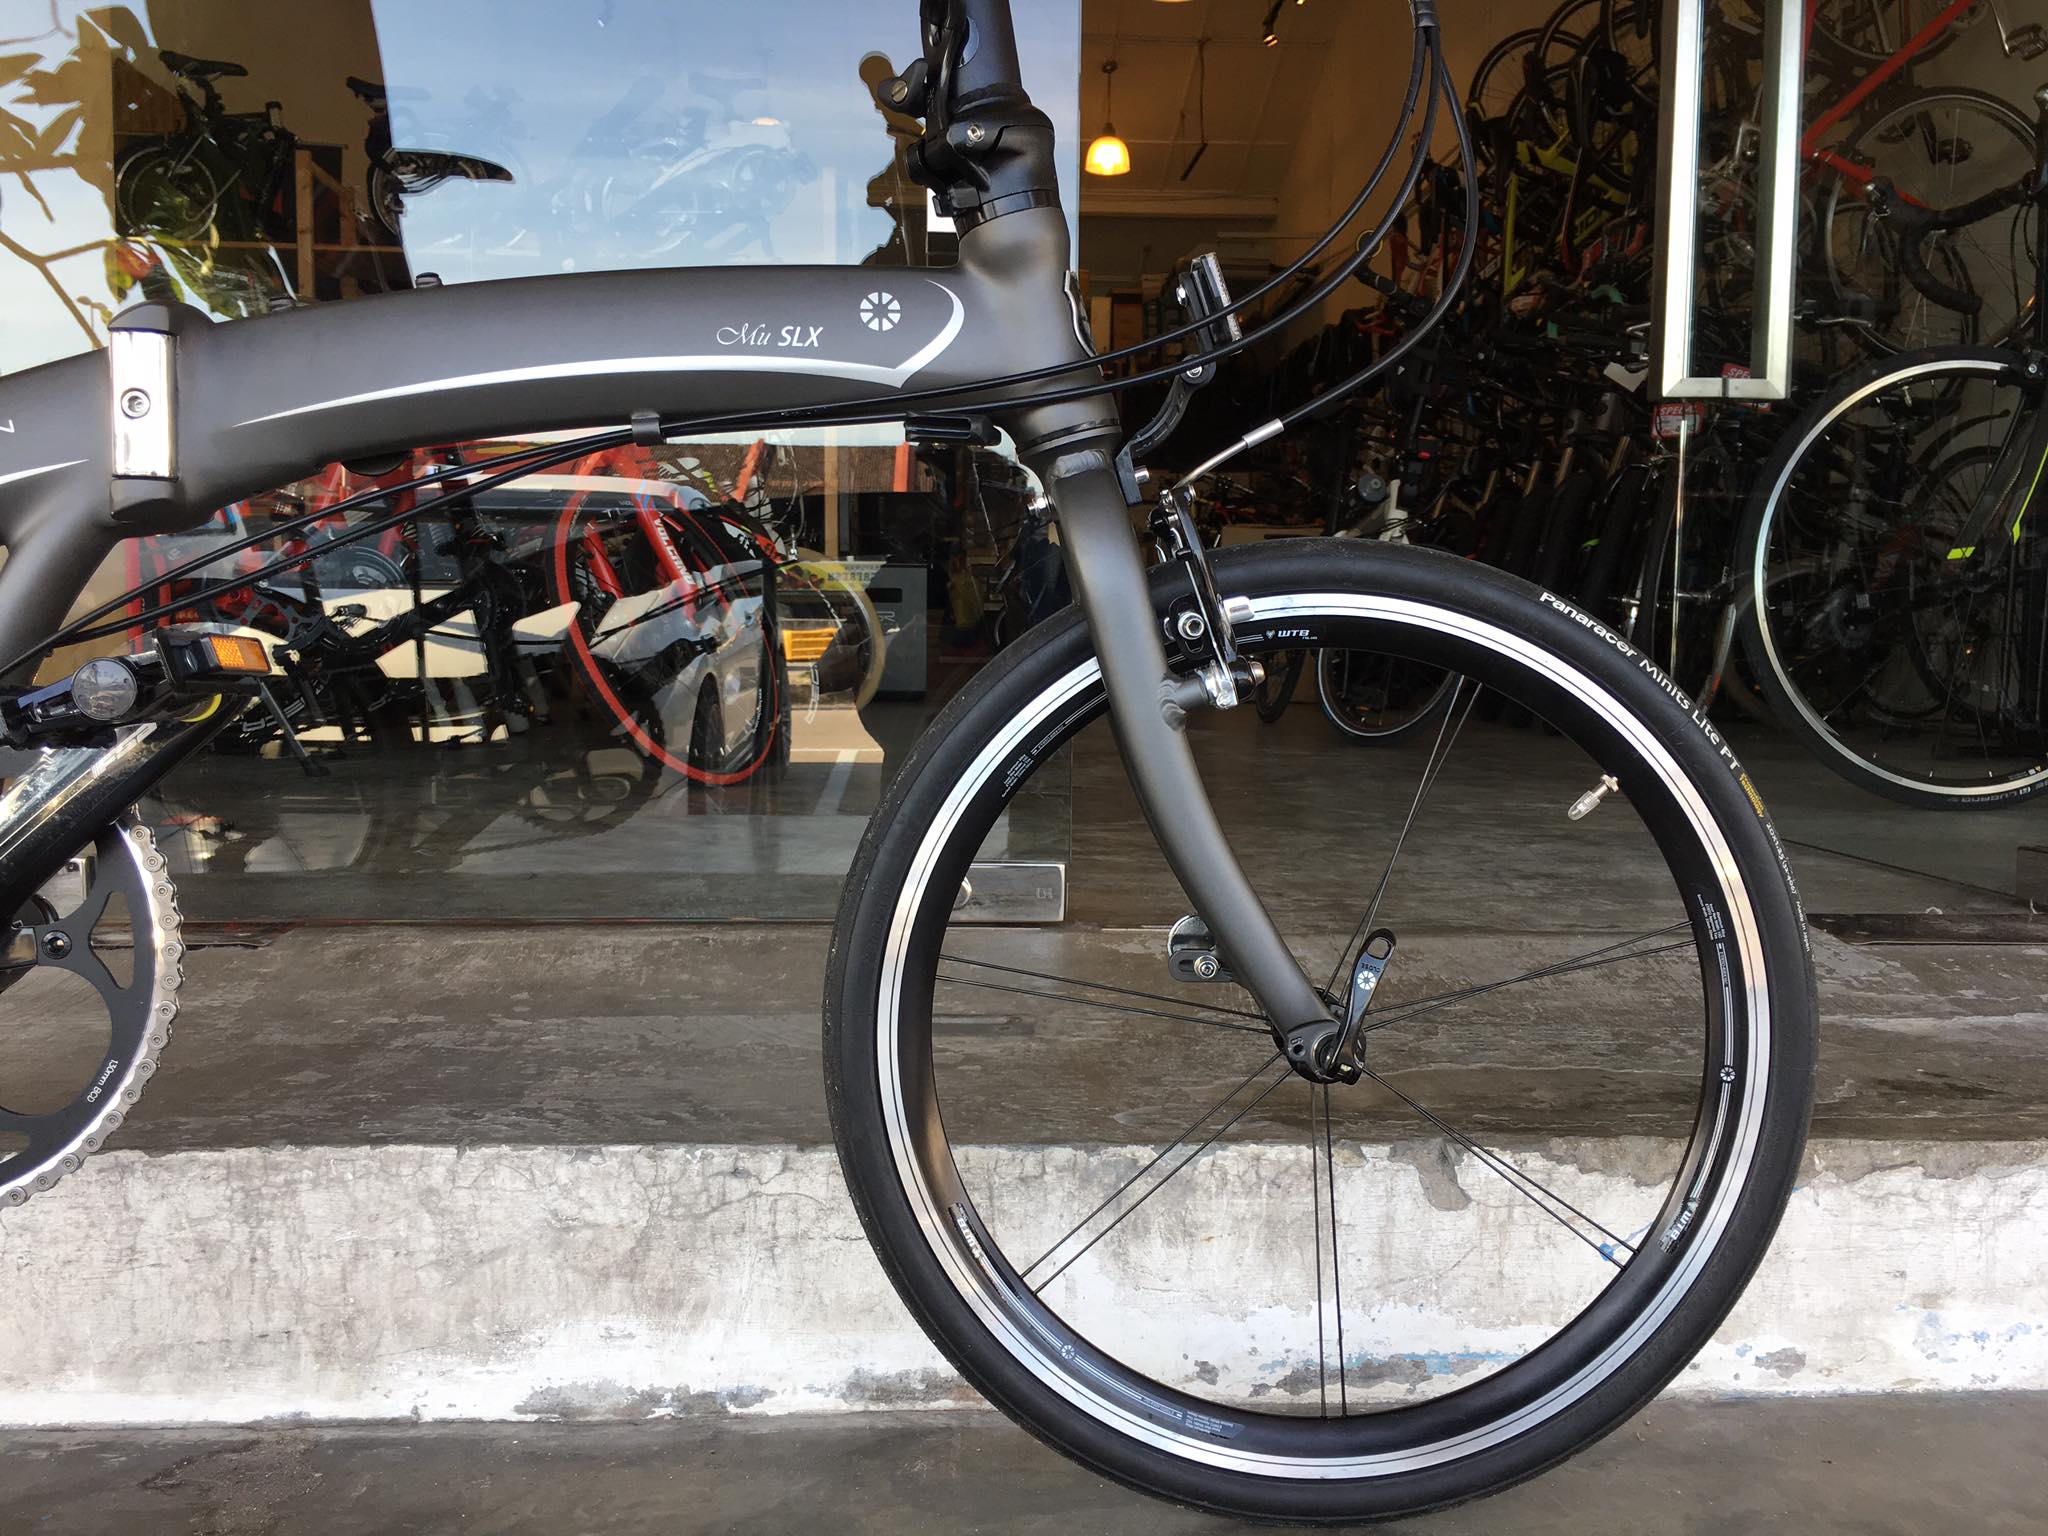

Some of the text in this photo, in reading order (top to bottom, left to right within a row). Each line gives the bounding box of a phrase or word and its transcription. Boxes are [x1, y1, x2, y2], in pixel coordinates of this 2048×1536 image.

[777, 325, 824, 347] SLX
[1277, 629, 1310, 637] WTB
[1540, 591, 1638, 657] Panaracer
[1692, 709, 1720, 745] Lite
[1720, 745, 1740, 770] PT
[86, 1059, 119, 1103] 130mm BCD
